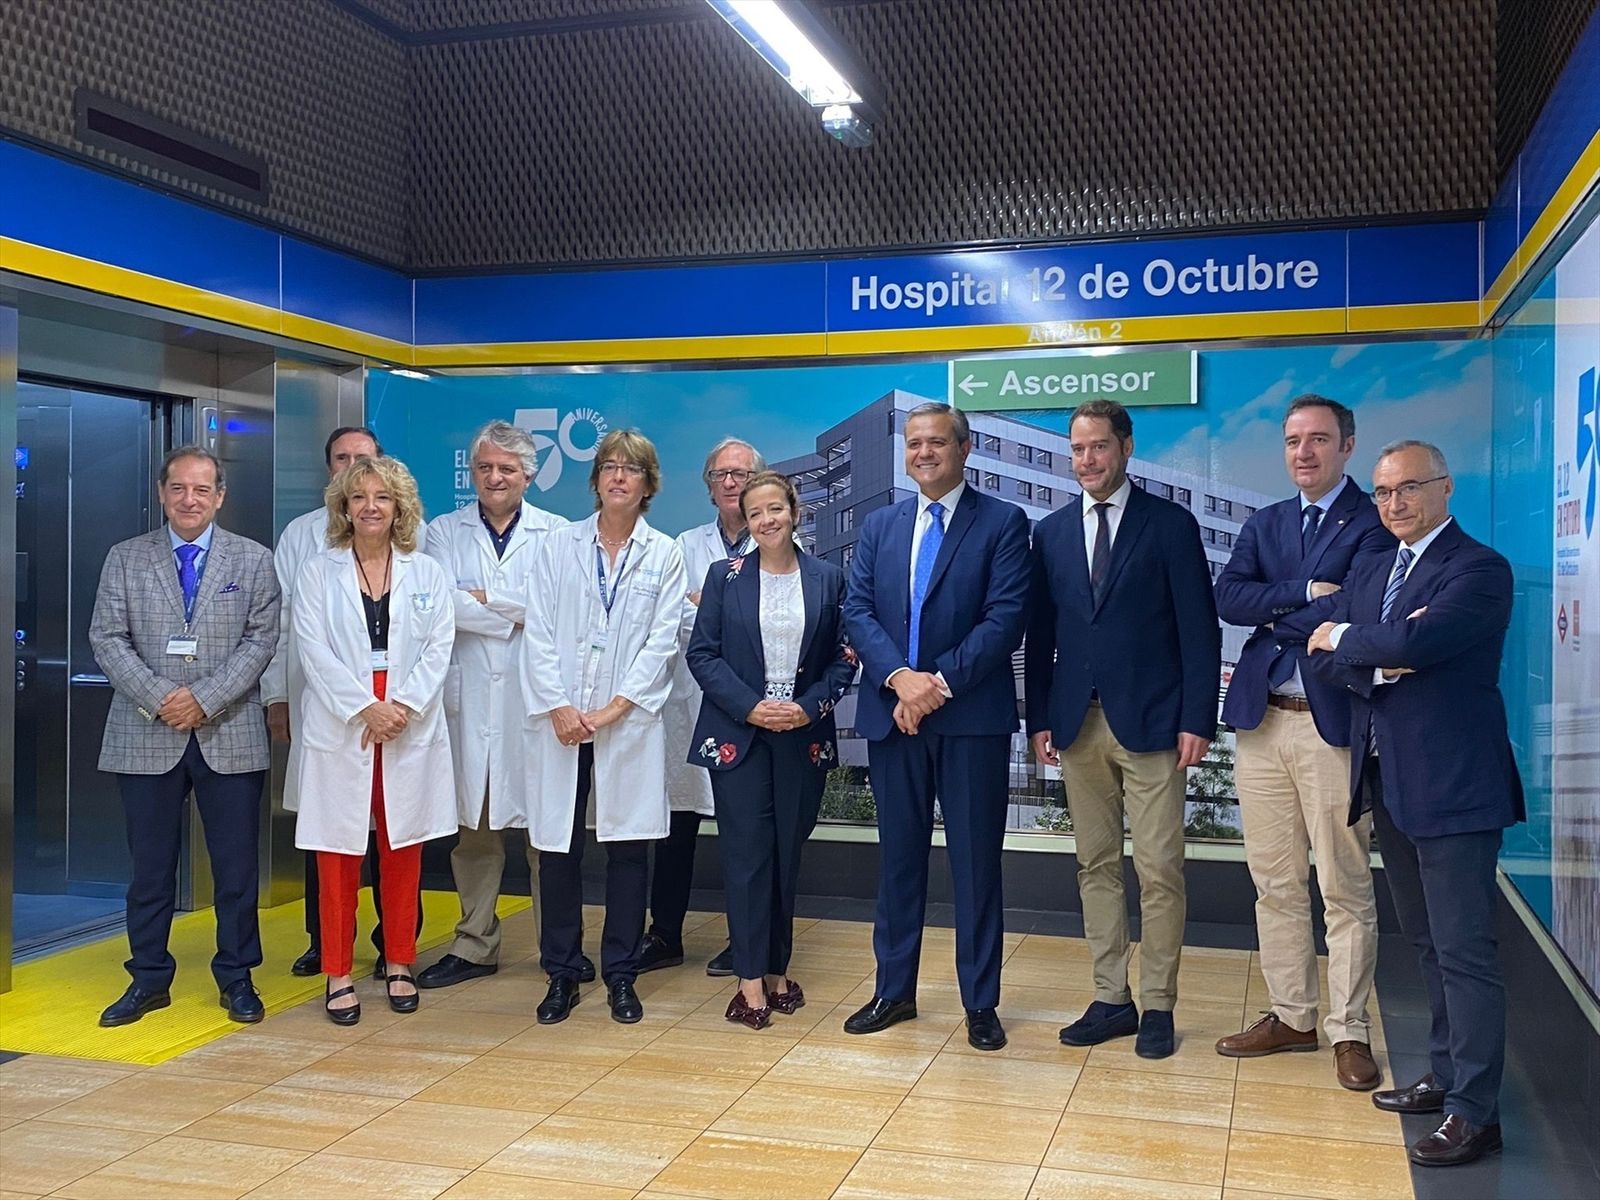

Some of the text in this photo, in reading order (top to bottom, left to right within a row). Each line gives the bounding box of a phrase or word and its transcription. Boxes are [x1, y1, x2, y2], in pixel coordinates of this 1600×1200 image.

[851, 253, 1320, 316] Hospital 12 de Octubre
[1110, 321, 1122, 339] 2
[999, 370, 1155, 396] Ascensor
[455, 450, 469, 468] EL
[455, 471, 470, 489] EN
